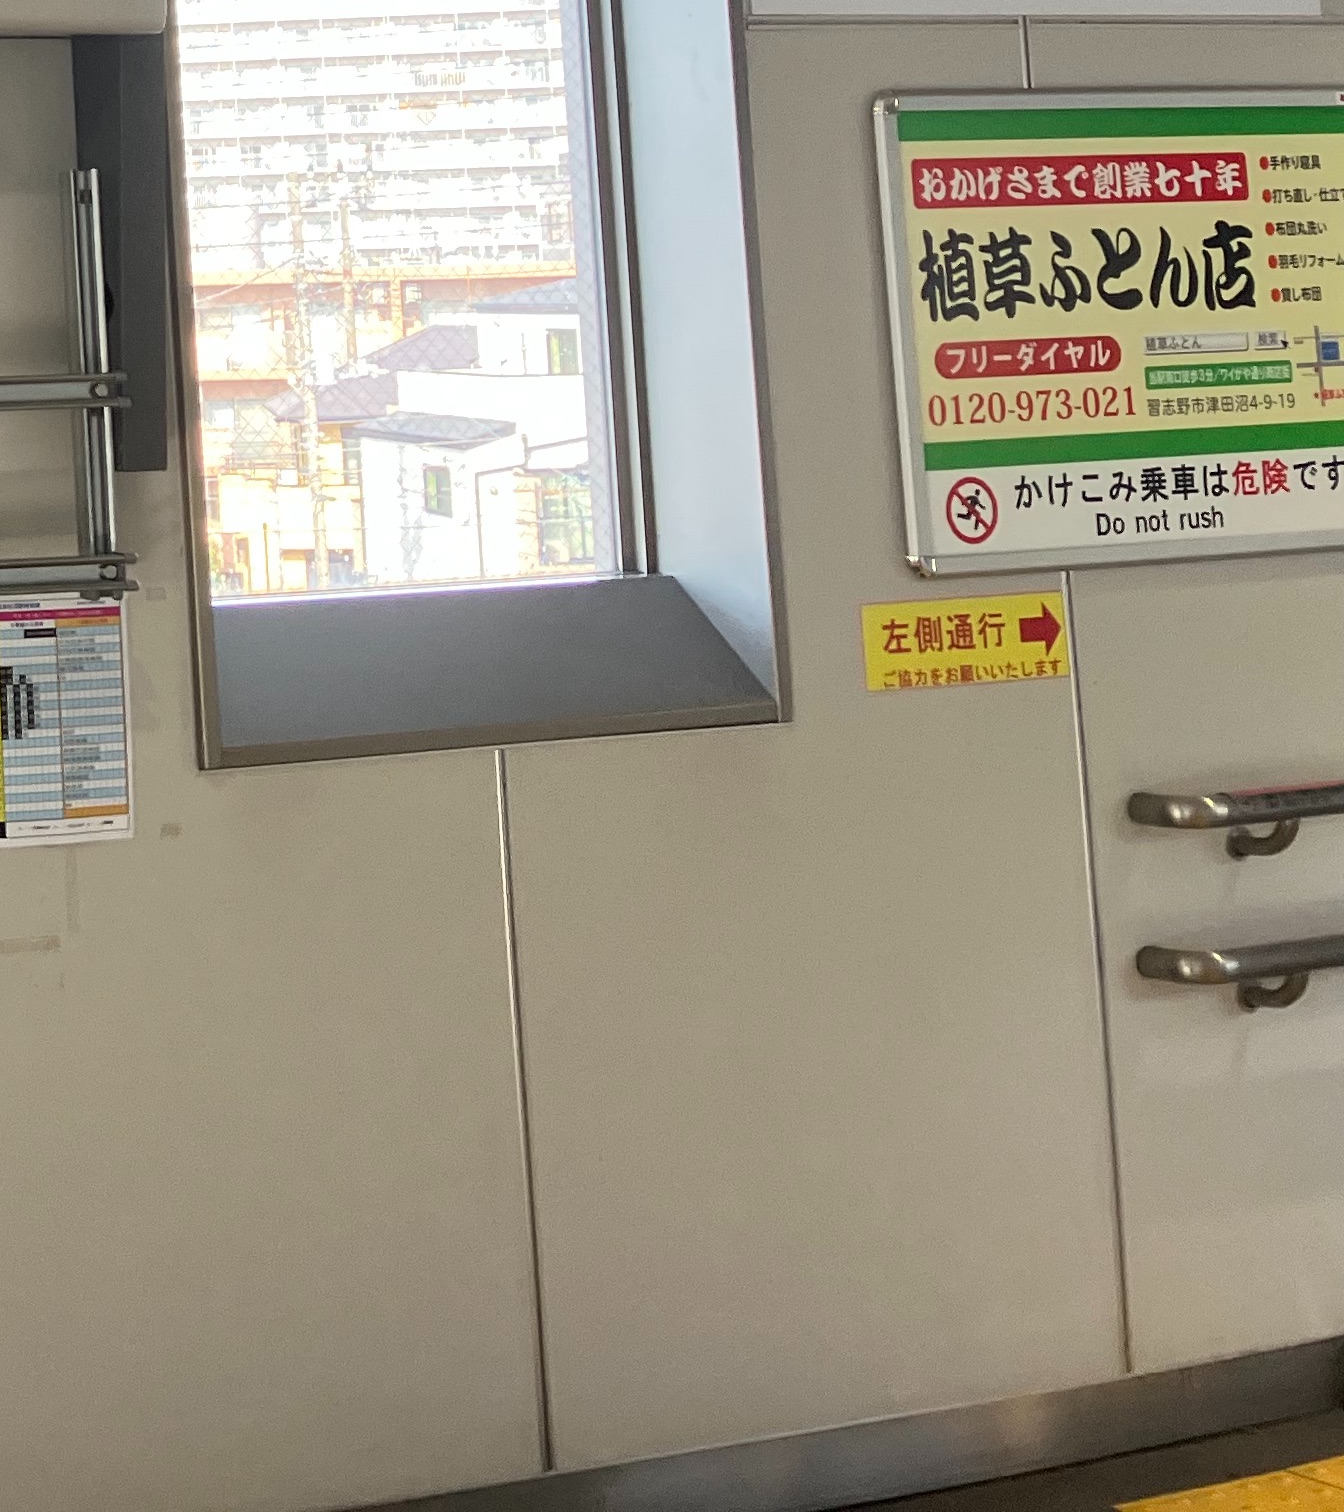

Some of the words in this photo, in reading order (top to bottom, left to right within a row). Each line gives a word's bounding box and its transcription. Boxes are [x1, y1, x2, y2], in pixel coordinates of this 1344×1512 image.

[919, 159, 1242, 202] おかげさまで創業七十年
[919, 220, 1256, 322] 植草ふとん店
[946, 340, 1110, 374] フリーダイヤル
[928, 386, 1136, 426] 0120-973-021
[1147, 393, 1296, 417] 習志野市津田沼4-9-19
[1015, 455, 1344, 509] かけこみ乗車は危険です
[1096, 513, 1125, 536] Do
[1135, 509, 1170, 534] not
[1180, 506, 1224, 530] rush
[882, 612, 1006, 654] 左側通行
[883, 659, 1062, 689] ご協力をお願いいたします
